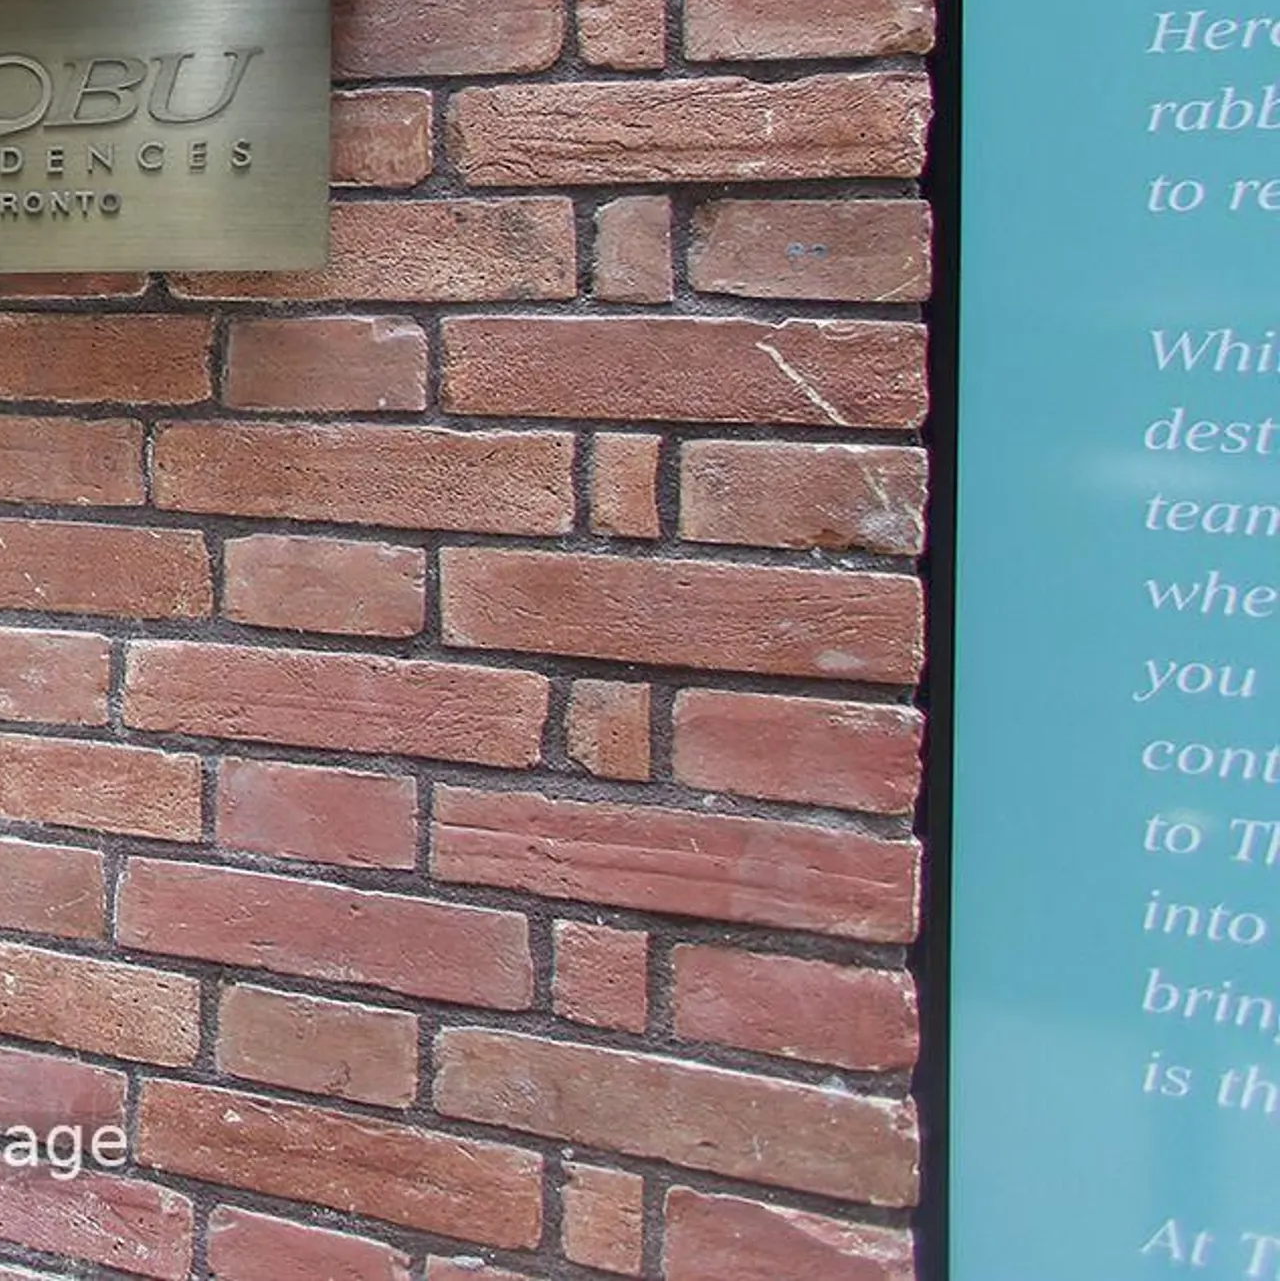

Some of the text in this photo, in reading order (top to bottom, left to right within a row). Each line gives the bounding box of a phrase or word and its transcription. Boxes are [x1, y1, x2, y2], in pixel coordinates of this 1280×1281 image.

[1148, 173, 1206, 212] to
[1149, 327, 1280, 373] Whi
[1143, 570, 1276, 618] whe
[1132, 659, 1257, 702] you
[1143, 813, 1201, 854] to
[1143, 889, 1266, 945] into
[1142, 967, 1280, 1044] brin
[1143, 1051, 1278, 1114] is th
[1140, 1218, 1214, 1267] At
